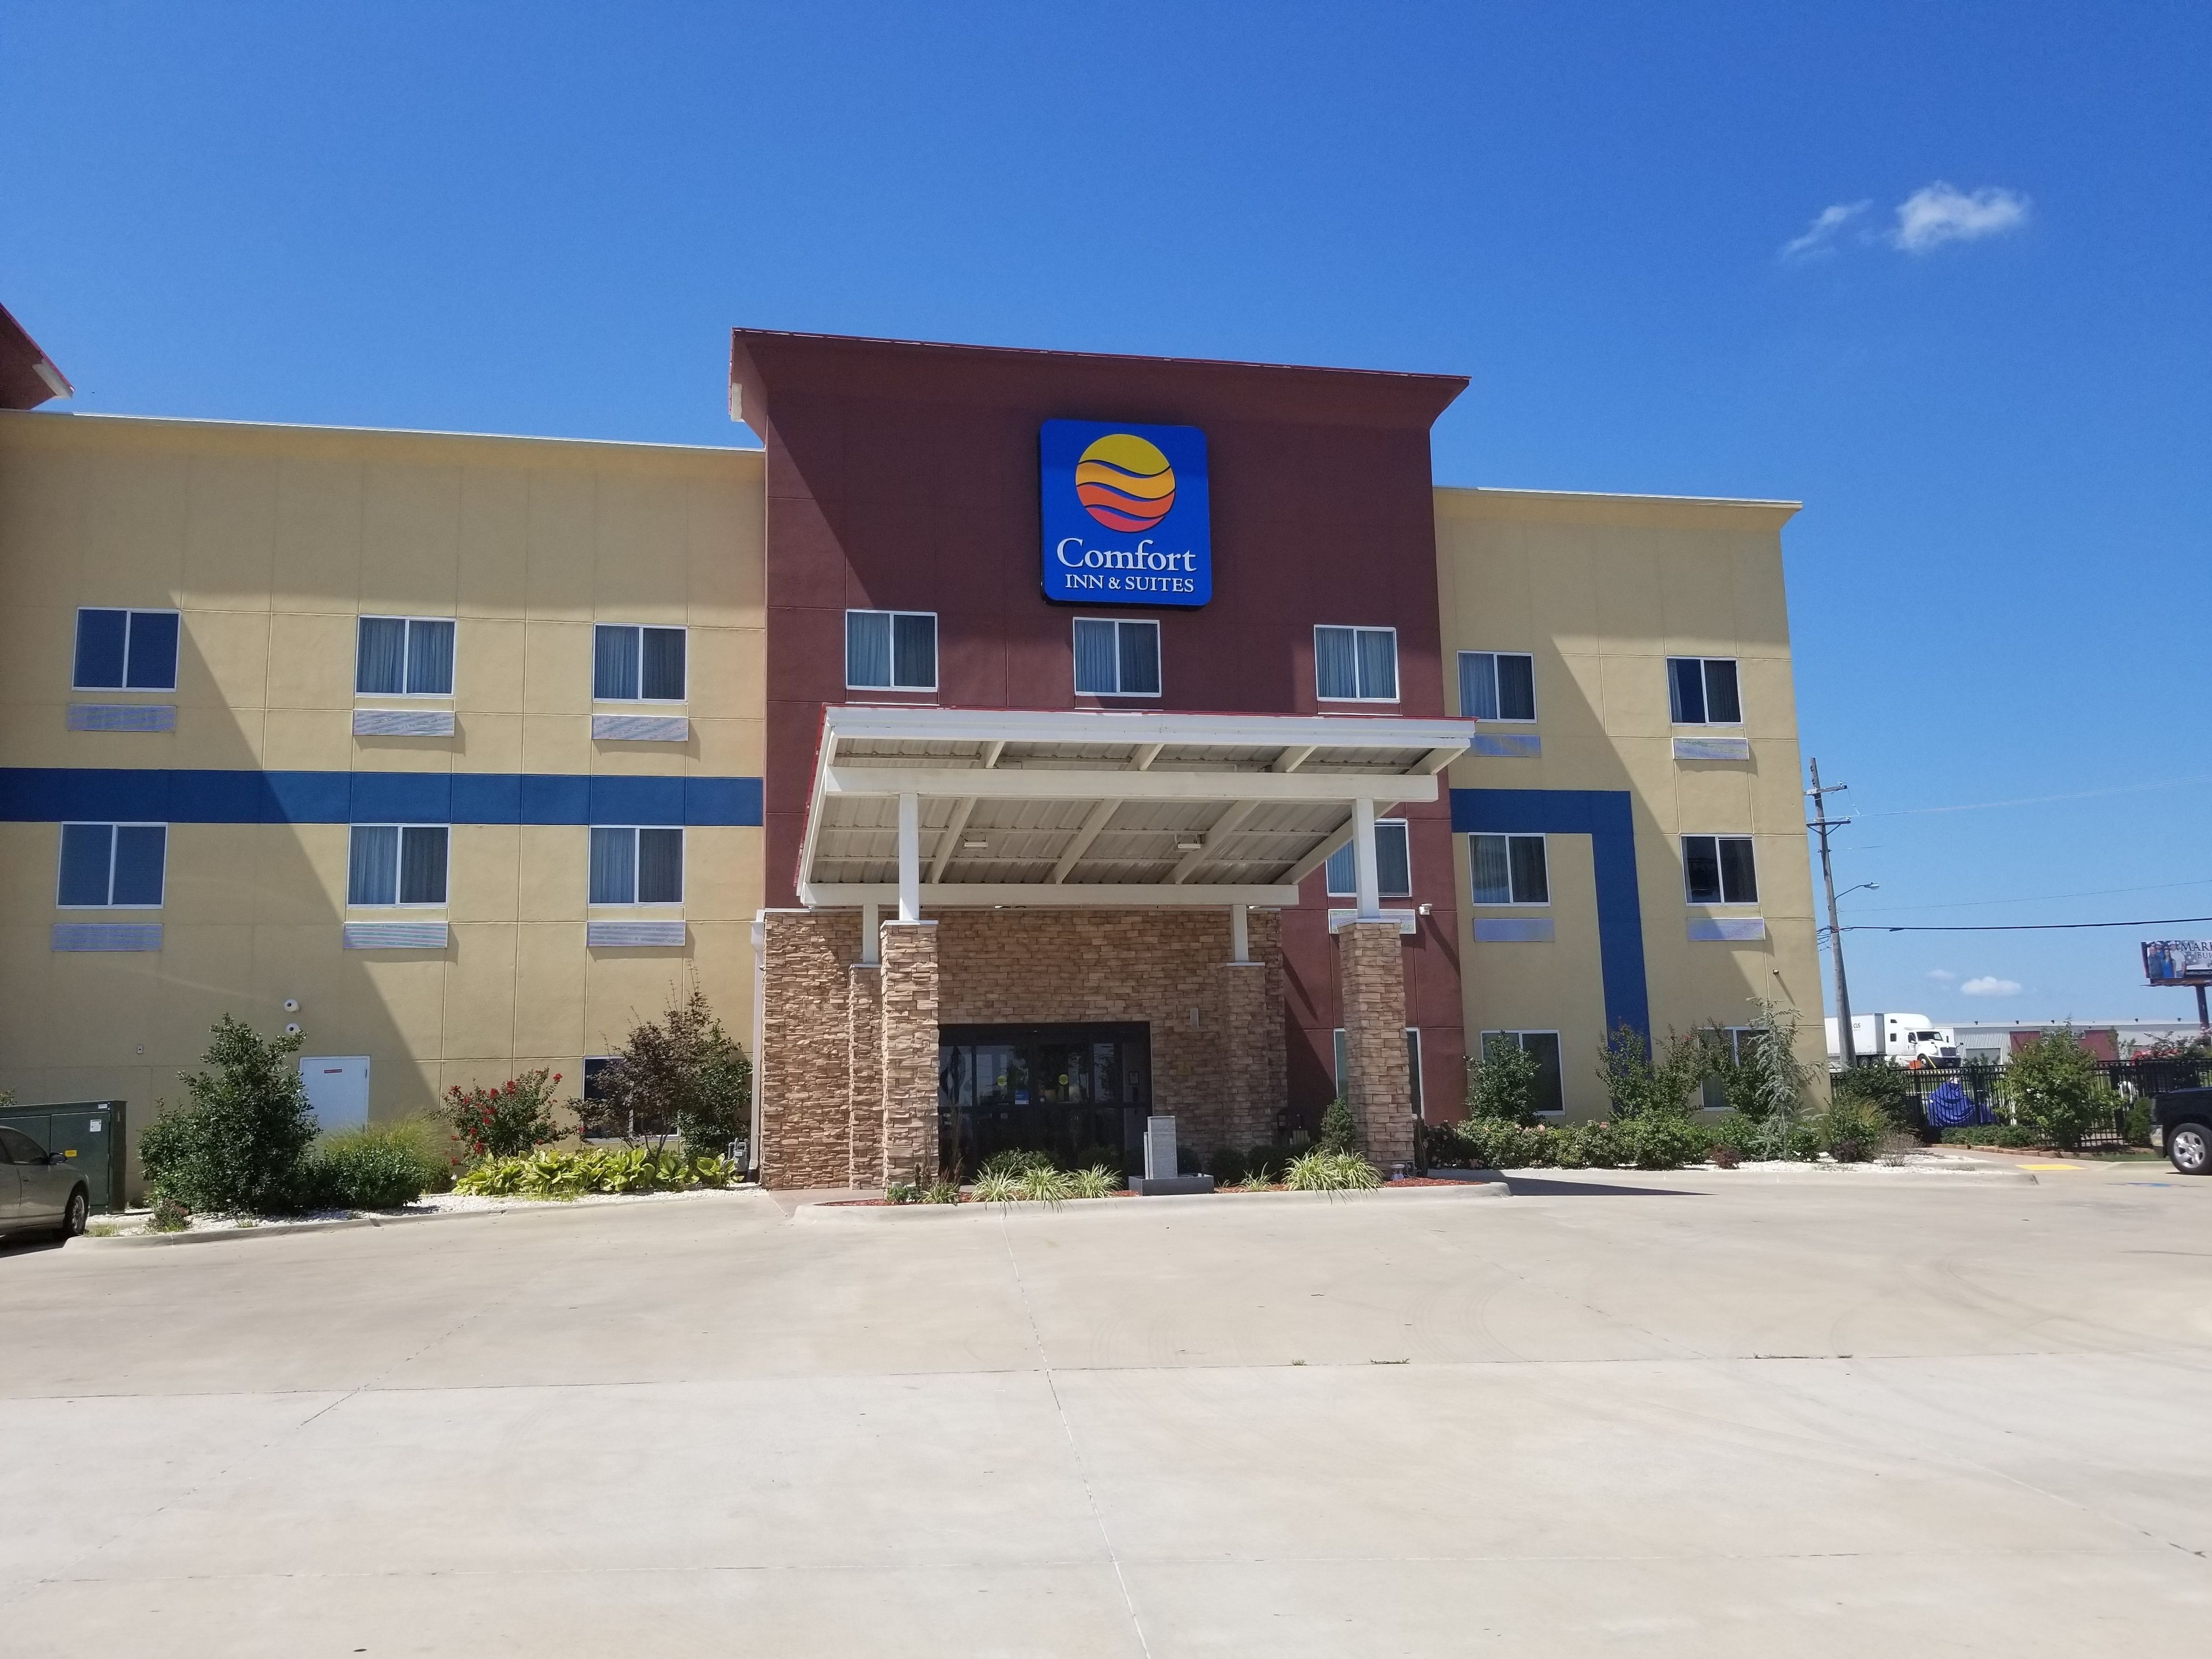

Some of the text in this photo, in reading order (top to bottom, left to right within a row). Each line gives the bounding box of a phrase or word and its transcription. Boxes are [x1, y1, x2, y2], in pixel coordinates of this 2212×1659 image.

[1056, 537, 1197, 572] Comfort
[1065, 574, 1195, 593] INN & SUITES
